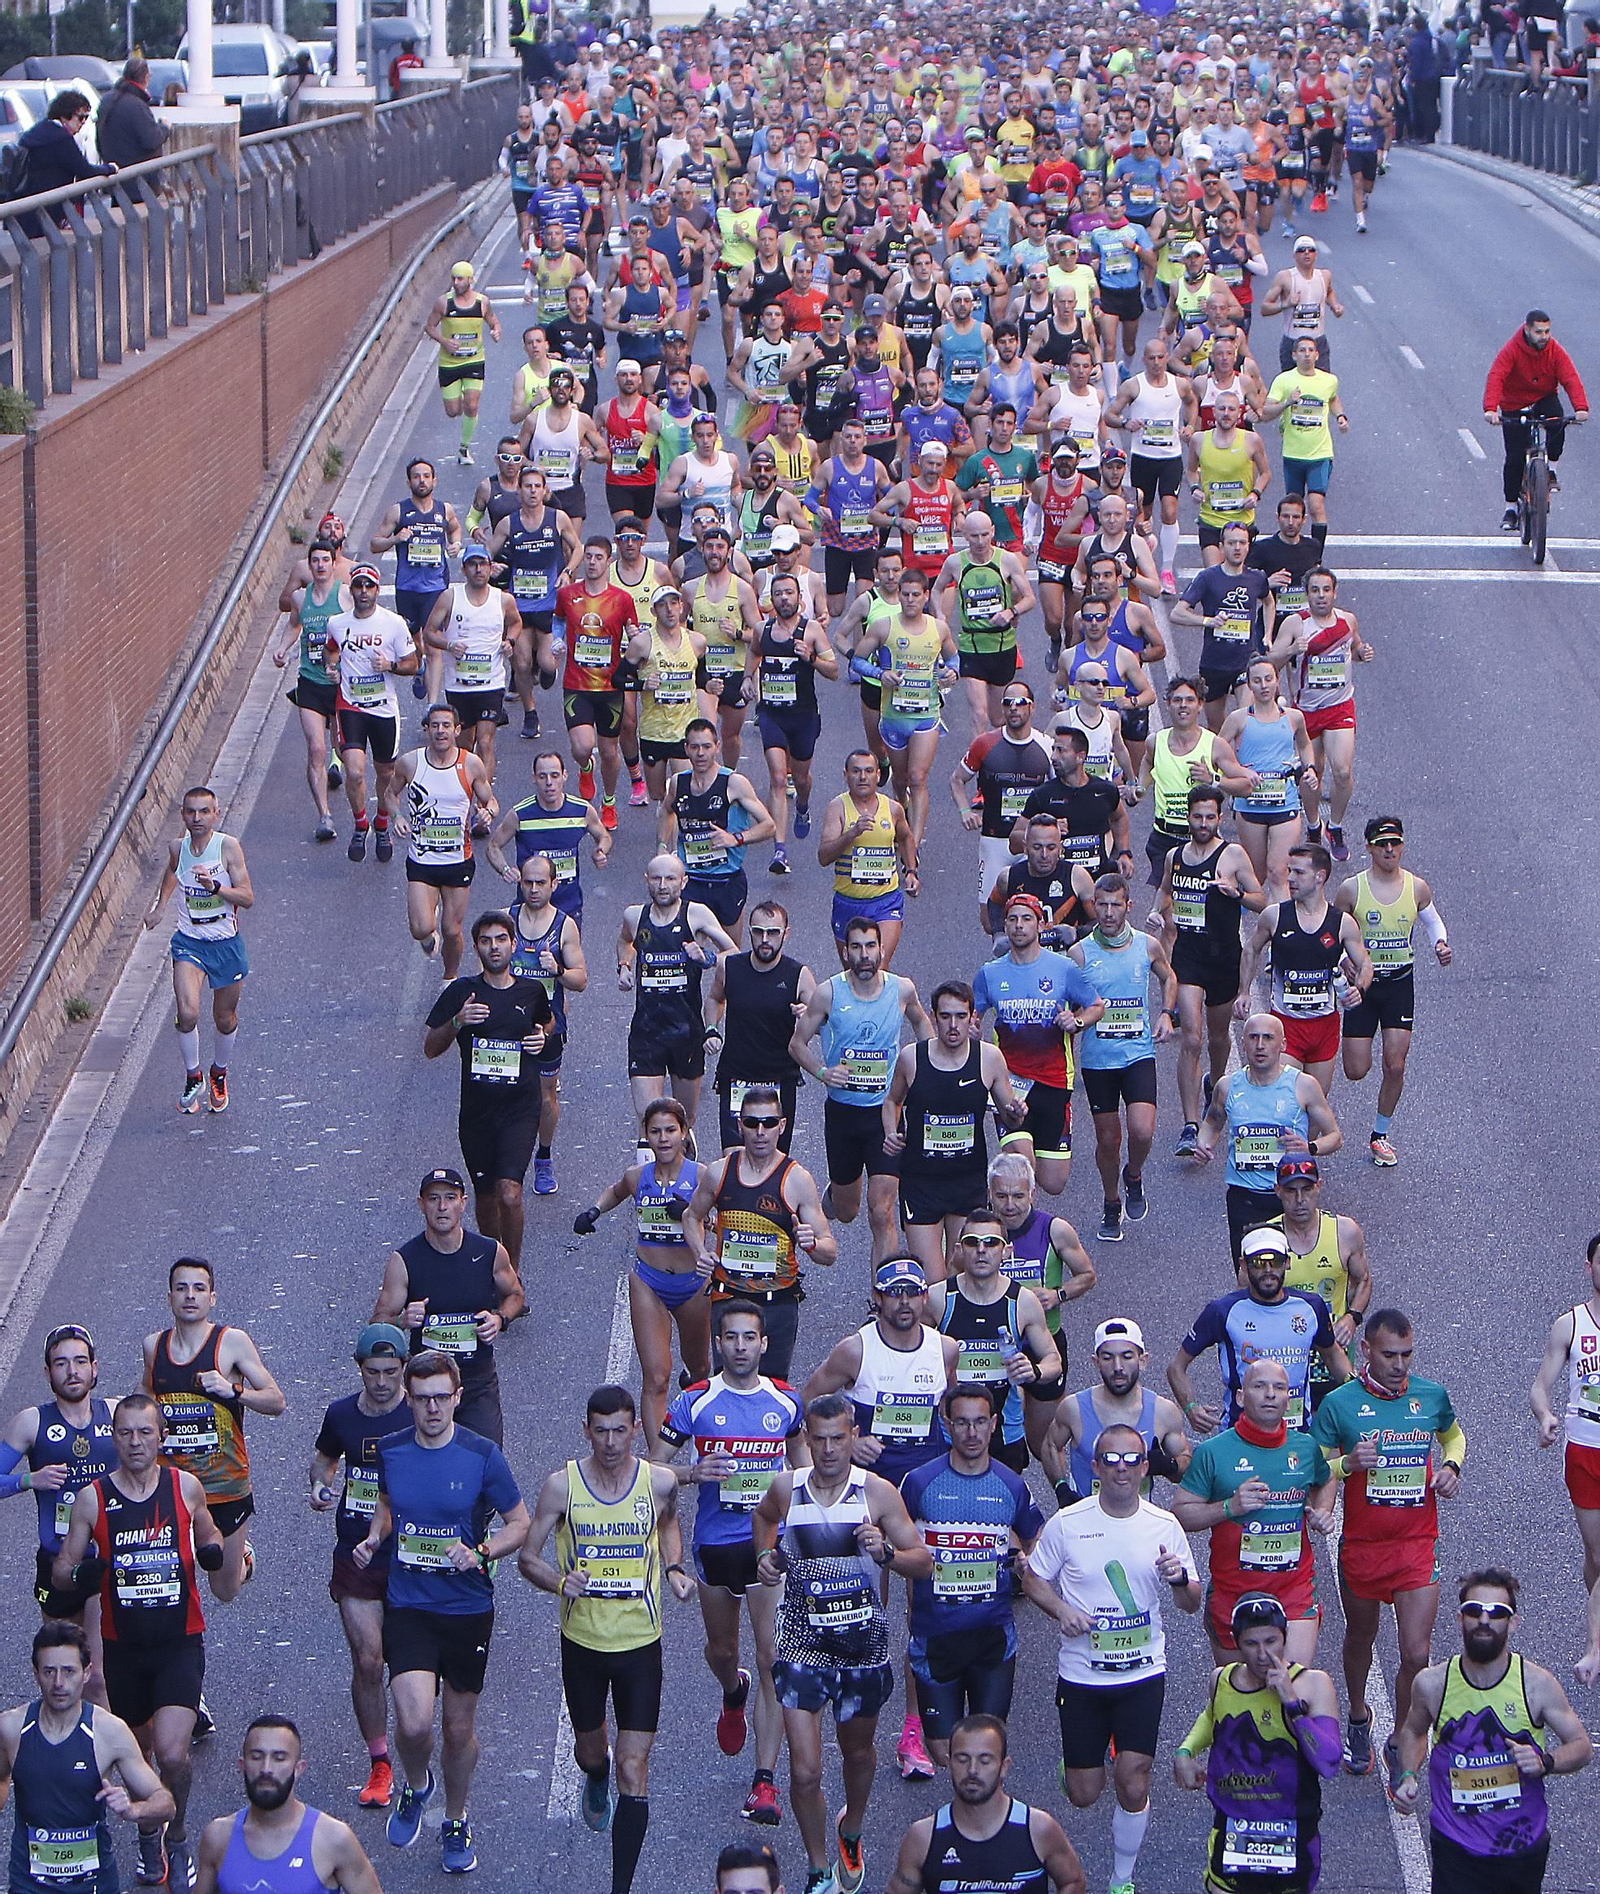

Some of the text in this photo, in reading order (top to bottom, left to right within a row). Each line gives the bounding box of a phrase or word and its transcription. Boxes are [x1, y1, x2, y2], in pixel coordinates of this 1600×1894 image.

[668, 672, 689, 680] ZURICH
[1071, 850, 1090, 858] 2010
[1379, 940, 1405, 948] ZURICH
[654, 953, 681, 962] ZURICH
[1298, 971, 1325, 979] ZURICH
[1298, 986, 1317, 994] 1714
[1112, 999, 1139, 1008] ZURICH
[1111, 1012, 1130, 1021] 1314
[488, 1041, 516, 1050] ZURICH
[856, 1051, 883, 1060] ZURICH
[856, 1065, 872, 1073] 790
[940, 1115, 970, 1125] ZURICH
[1249, 1142, 1270, 1151] 1307
[440, 1315, 471, 1324] ZURICH
[968, 1341, 998, 1350] ZURIC
[967, 1358, 991, 1367] 1090
[895, 1396, 928, 1405] ZURICH
[174, 1406, 207, 1416] ZURICH
[894, 1412, 912, 1422] 858
[890, 1426, 913, 1435] PRUNA
[731, 1440, 786, 1455] PUEBLA
[740, 1460, 772, 1470] ZURICH
[1388, 1456, 1422, 1466] ZURICH
[362, 1472, 379, 1480] ZUR
[1387, 1474, 1410, 1483] 1127
[741, 1479, 759, 1488] 802
[740, 1493, 760, 1502] JESUS
[418, 1526, 454, 1536] ZURICH
[1263, 1523, 1296, 1533] ZURICH
[936, 1535, 995, 1547] SPAR
[1263, 1540, 1282, 1549] 770
[419, 1542, 438, 1552] 827
[599, 1547, 637, 1557] ZURICH
[134, 1553, 171, 1564] ZURICH
[416, 1555, 443, 1565] CATHAL
[954, 1551, 990, 1561] ZURICH
[1260, 1554, 1283, 1563] PEDRO
[602, 1567, 620, 1577] 531
[955, 1570, 975, 1579] 918
[135, 1573, 162, 1585] 2350
[824, 1579, 861, 1591] ZURICH
[958, 1583, 991, 1592] MANZANO
[135, 1587, 164, 1596] SERVAN
[826, 1601, 853, 1612] 1915
[1112, 1617, 1145, 1628] ZURICH
[1113, 1637, 1132, 1647] 774
[1468, 1754, 1508, 1766] ZURICH
[1470, 1776, 1498, 1789] 3316
[1249, 1821, 1288, 1832] ZURICH
[50, 1829, 89, 1840] ZURICH
[1247, 1842, 1275, 1855] 2327
[53, 1850, 74, 1860] 758
[45, 1864, 85, 1874] TOULOUSE
